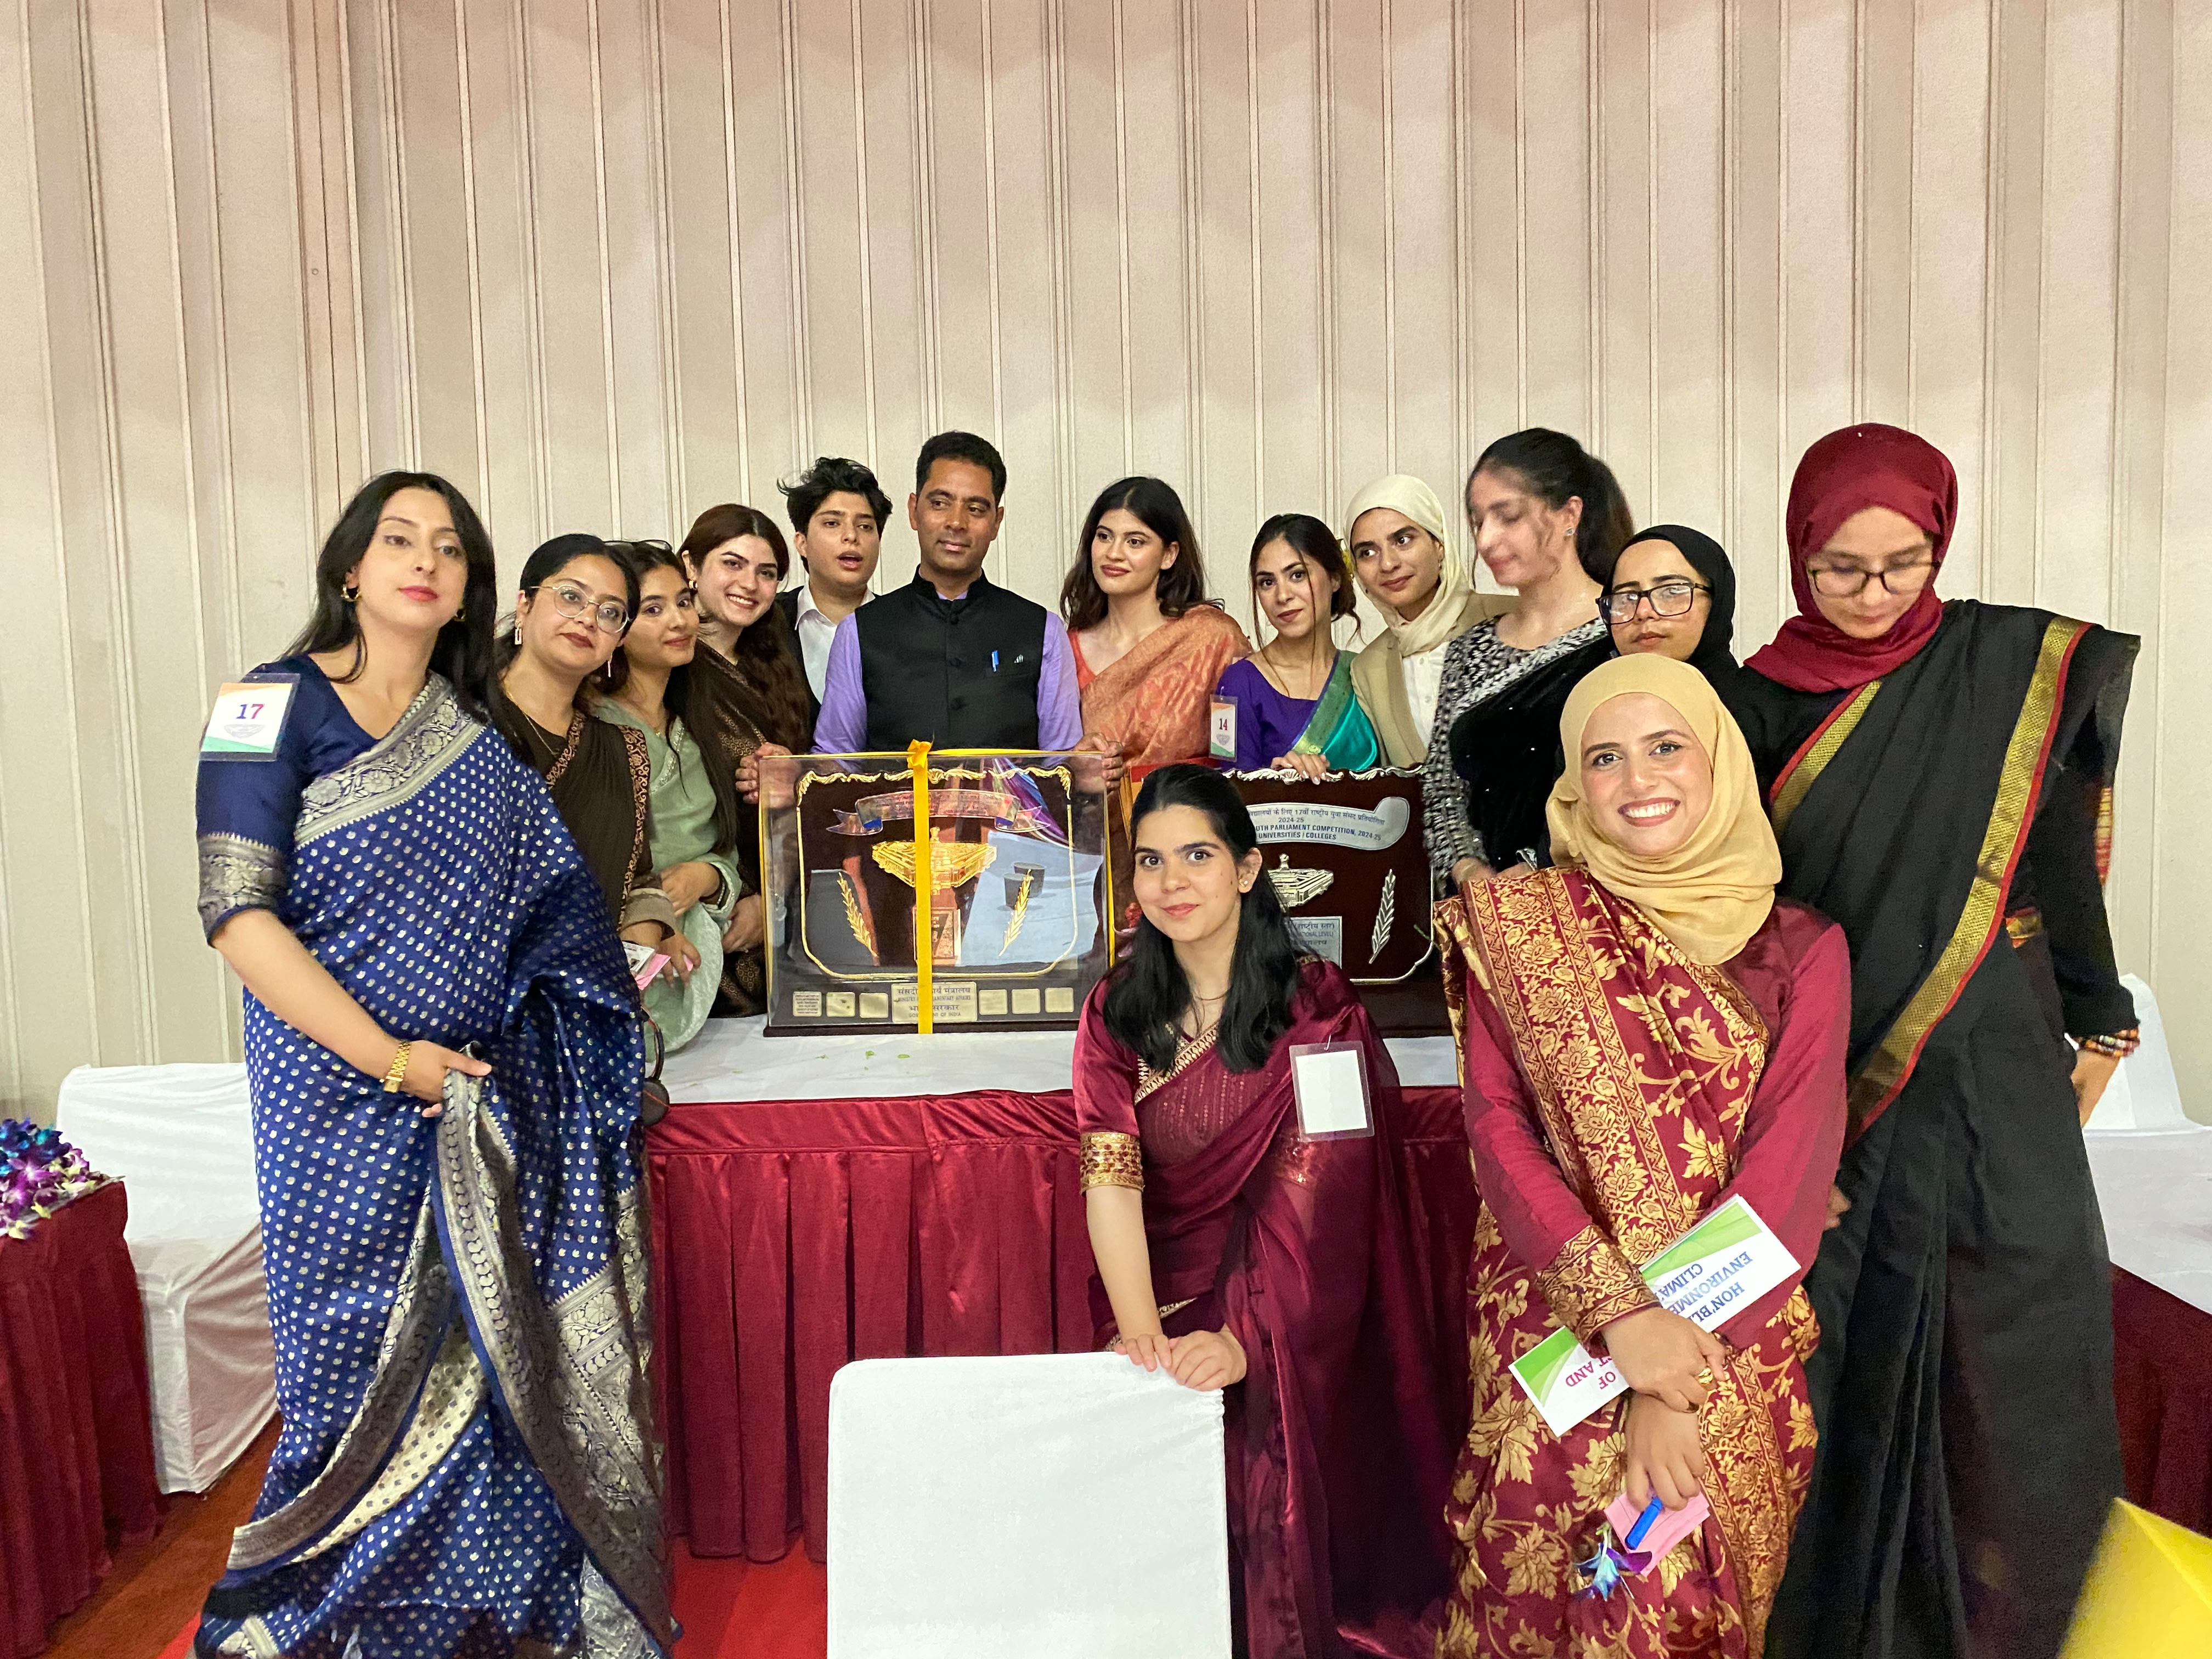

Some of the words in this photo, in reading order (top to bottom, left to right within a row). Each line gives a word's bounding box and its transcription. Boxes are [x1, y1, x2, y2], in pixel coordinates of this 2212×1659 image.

[236, 703, 265, 719] 17
[1219, 718, 1228, 730] 14
[1312, 825, 1356, 836] COMPETITION,
[1655, 1263, 1703, 1301] CLIMA
[1666, 1251, 1753, 1315] ENVIRONME
[1688, 1282, 1745, 1322] HON'BL
[1565, 1361, 1594, 1387] AND
[1598, 1372, 1616, 1390] OF
